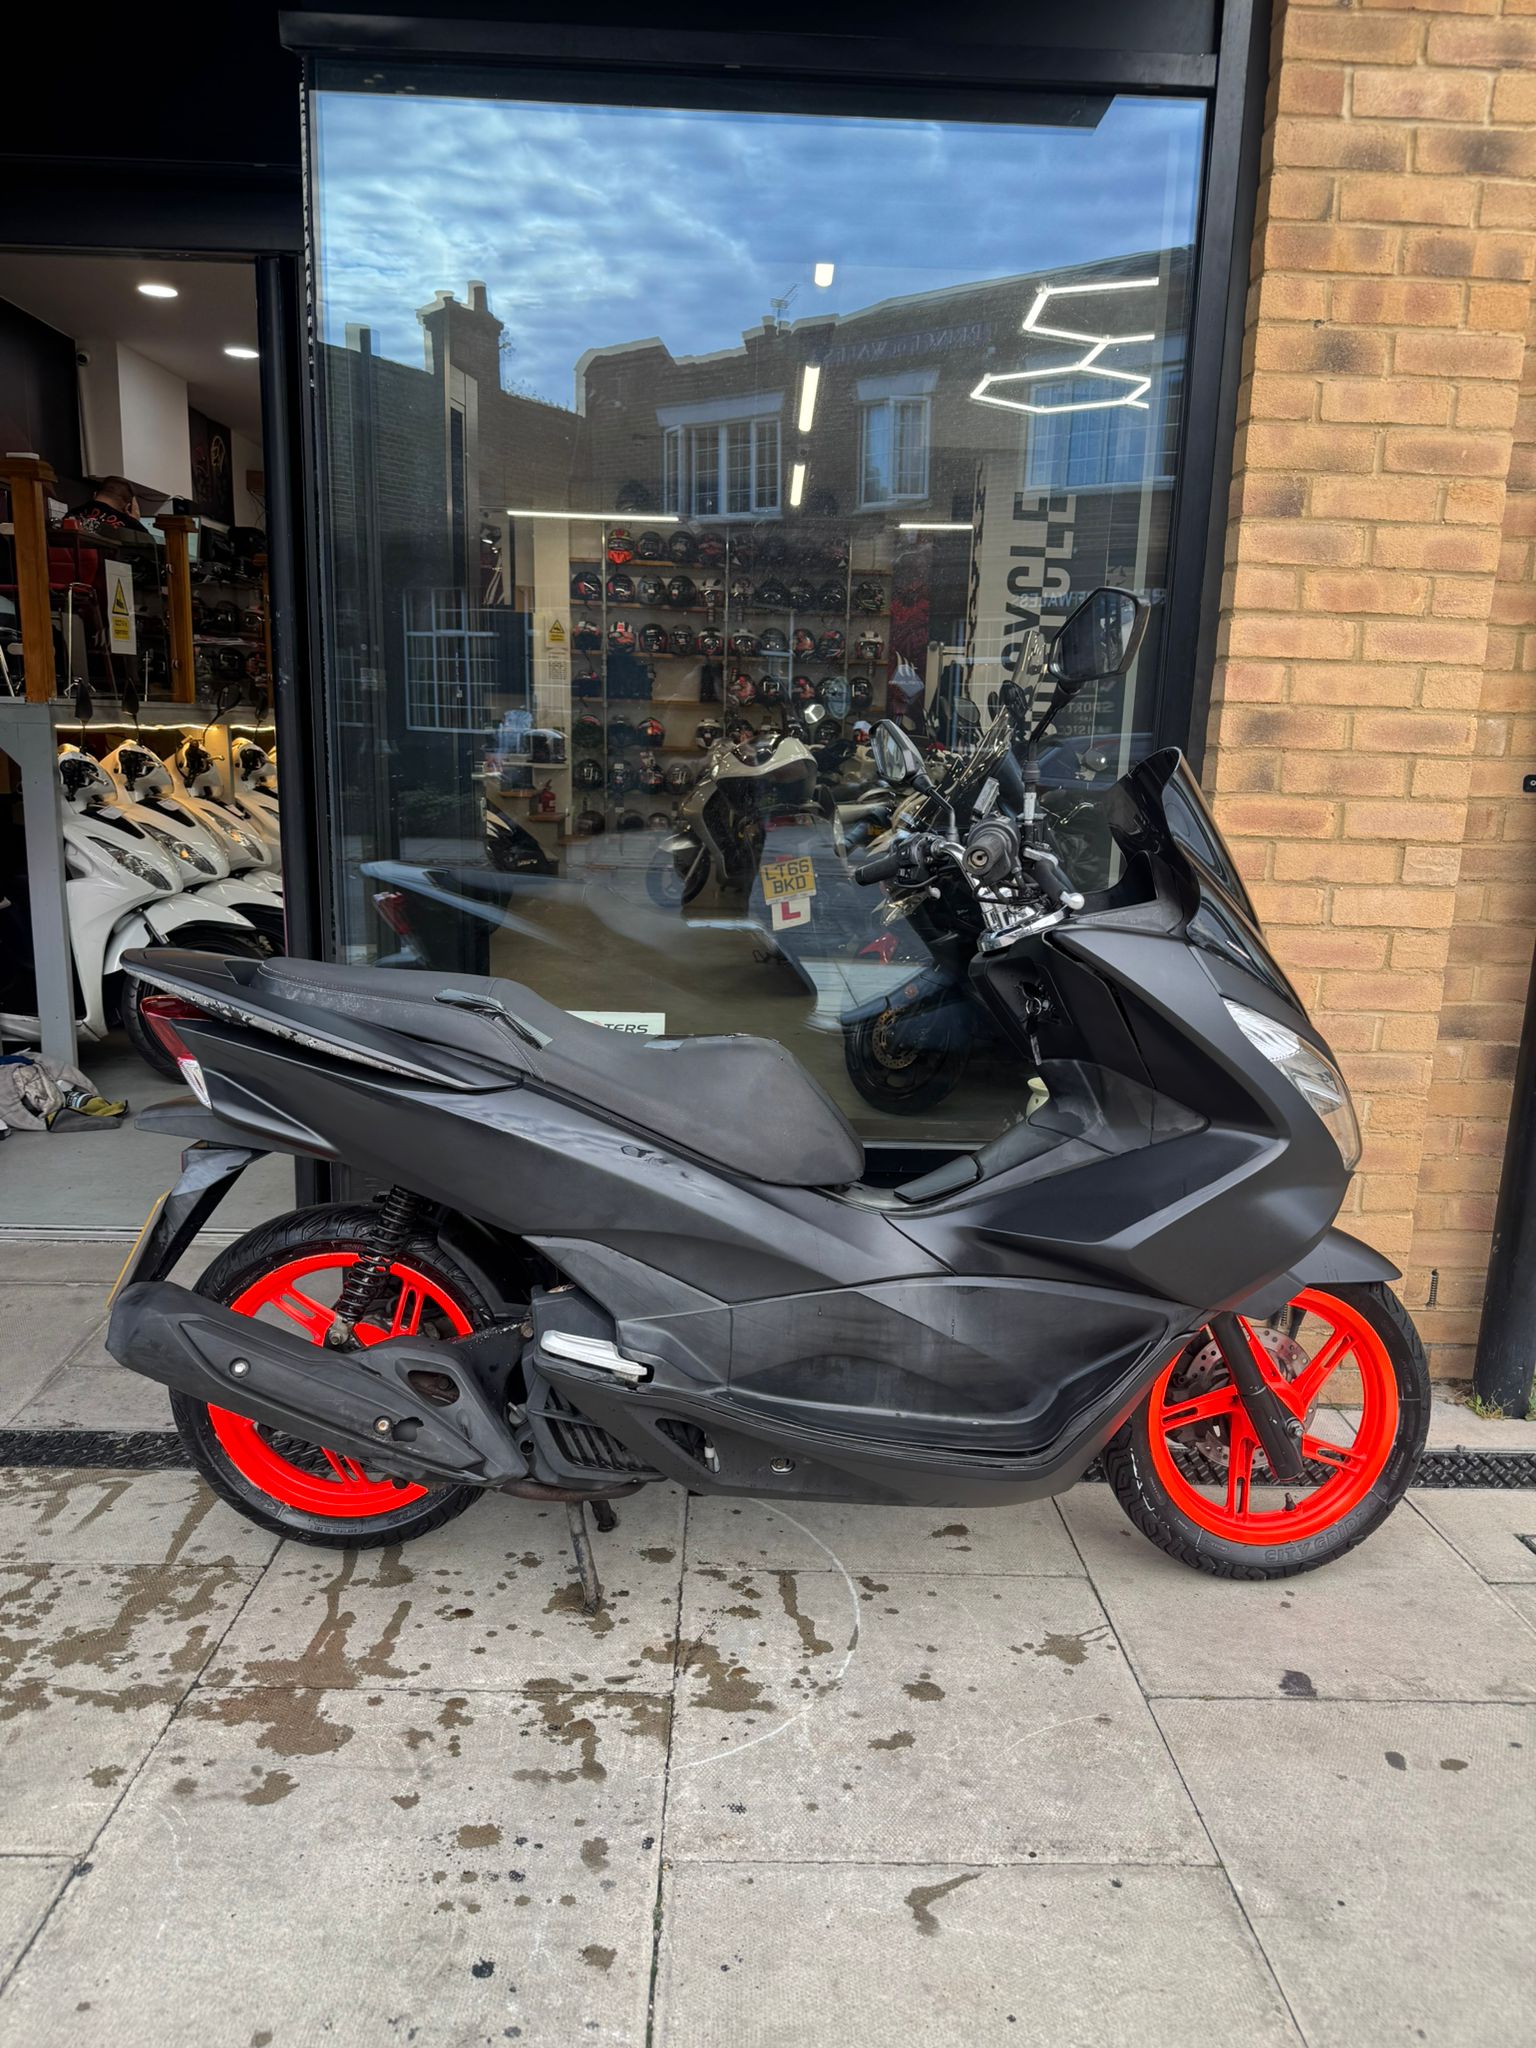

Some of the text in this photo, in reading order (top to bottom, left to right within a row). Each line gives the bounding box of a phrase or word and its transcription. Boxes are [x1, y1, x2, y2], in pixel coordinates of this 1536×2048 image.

[765, 859, 809, 881] LT66
[773, 875, 806, 894] BKD
[781, 901, 801, 921] L
[604, 1023, 649, 1034] TERS
[1265, 1543, 1312, 1563] CITY
[1314, 1519, 1356, 1551] GRIP
